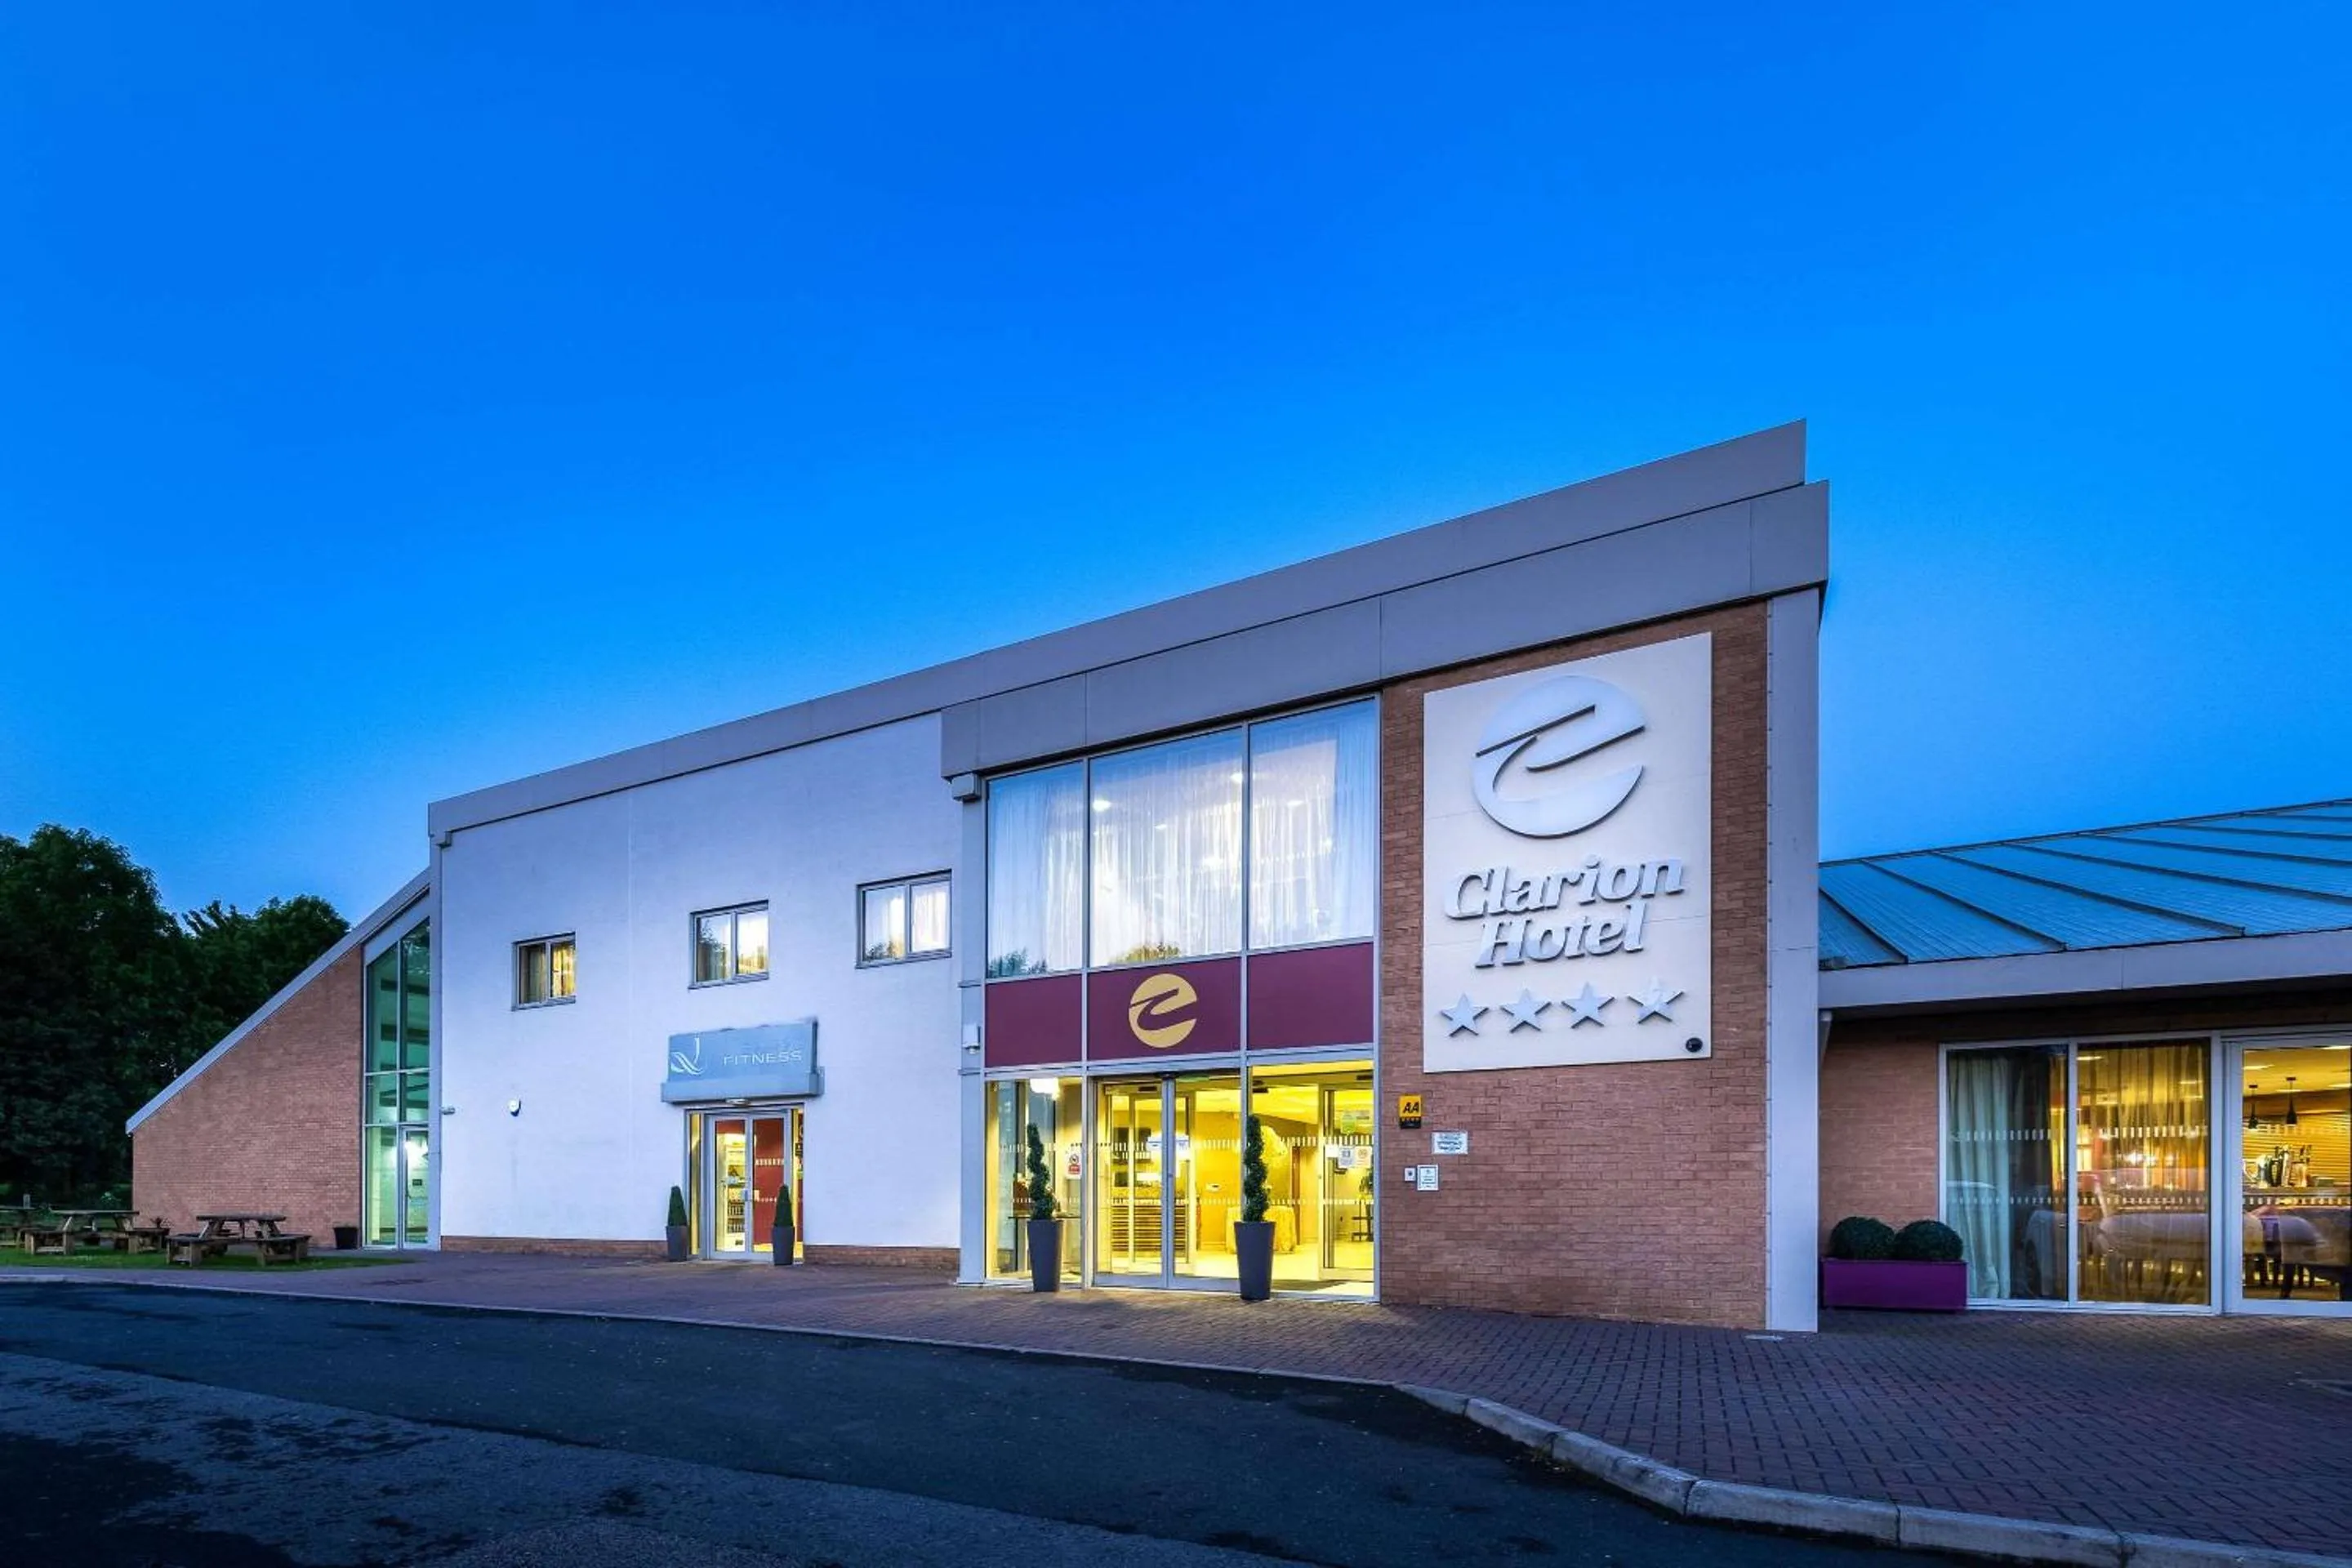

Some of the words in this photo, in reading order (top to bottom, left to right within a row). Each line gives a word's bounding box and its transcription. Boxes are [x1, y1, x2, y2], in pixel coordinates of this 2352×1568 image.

[1446, 855, 1685, 920] Clarion
[1474, 902, 1646, 969] Hotel
[723, 1049, 802, 1066] FITNESS
[1403, 1102, 1419, 1113] AA
